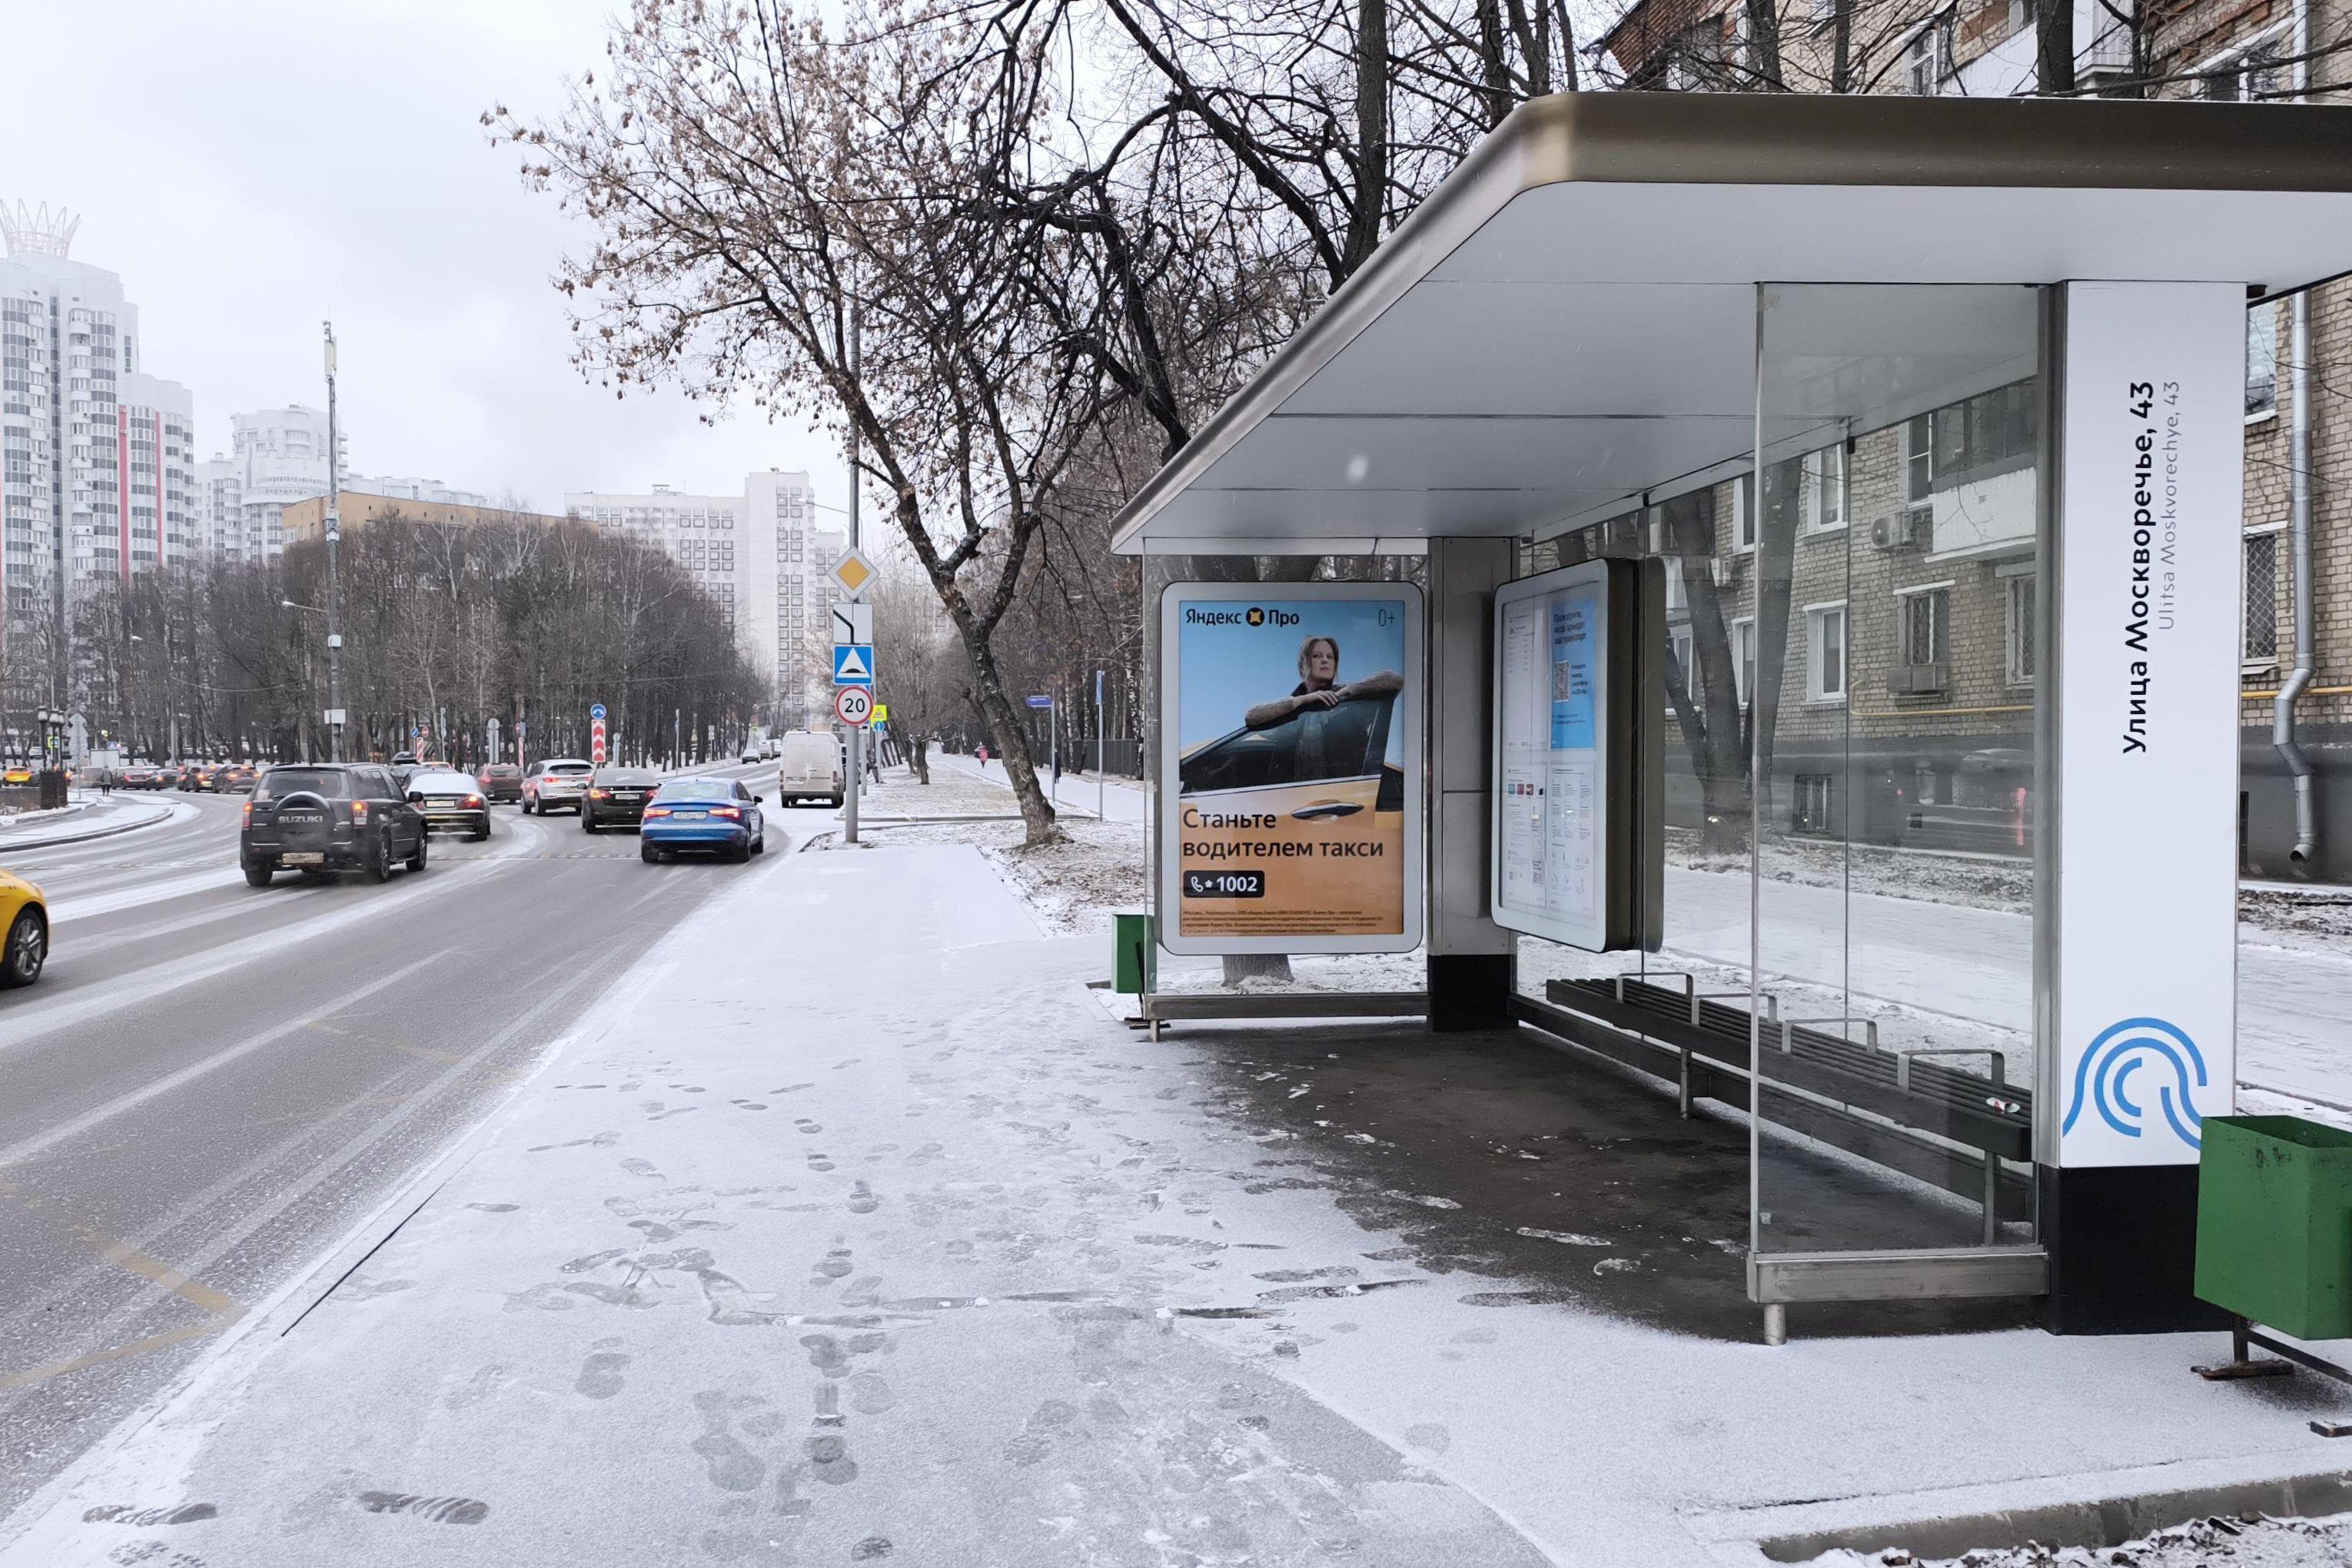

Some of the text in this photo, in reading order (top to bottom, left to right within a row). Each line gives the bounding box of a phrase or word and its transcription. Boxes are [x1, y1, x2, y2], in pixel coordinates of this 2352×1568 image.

[2158, 381, 2182, 630] Ulitsa Moskvorechye, 43
[2122, 382, 2158, 754] Улица Москворечье, 43
[1186, 609, 1300, 627] Яндекс Про
[1378, 608, 1396, 627] 0+
[844, 698, 865, 713] 20
[1183, 809, 1277, 829] Станьте
[1183, 842, 1384, 860] водителем такси
